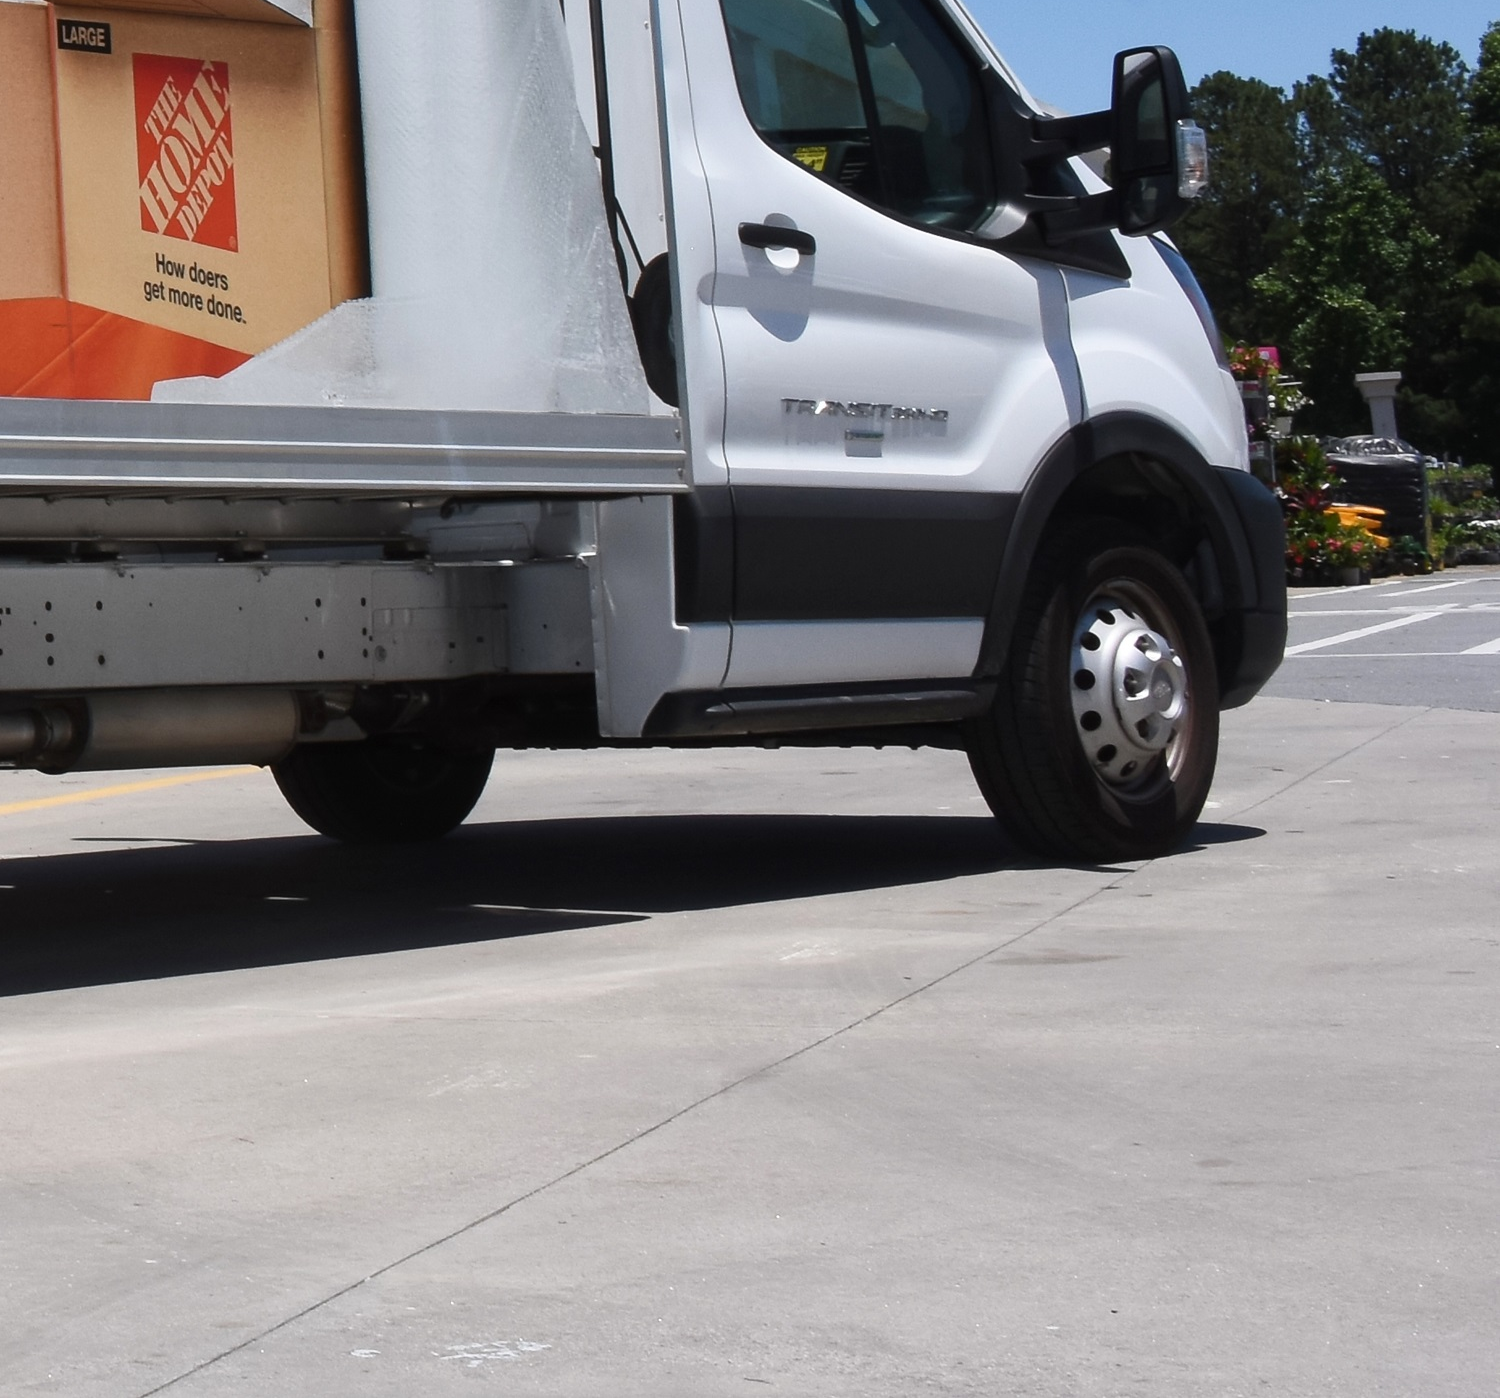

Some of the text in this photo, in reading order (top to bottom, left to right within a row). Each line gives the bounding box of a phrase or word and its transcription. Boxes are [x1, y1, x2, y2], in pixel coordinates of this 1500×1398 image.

[62, 25, 105, 47] LARGE
[144, 75, 183, 145] THE
[139, 59, 232, 235] HOME
[176, 131, 234, 242] DEPOT
[155, 252, 229, 291] How doers
[143, 279, 247, 325] get more done.
